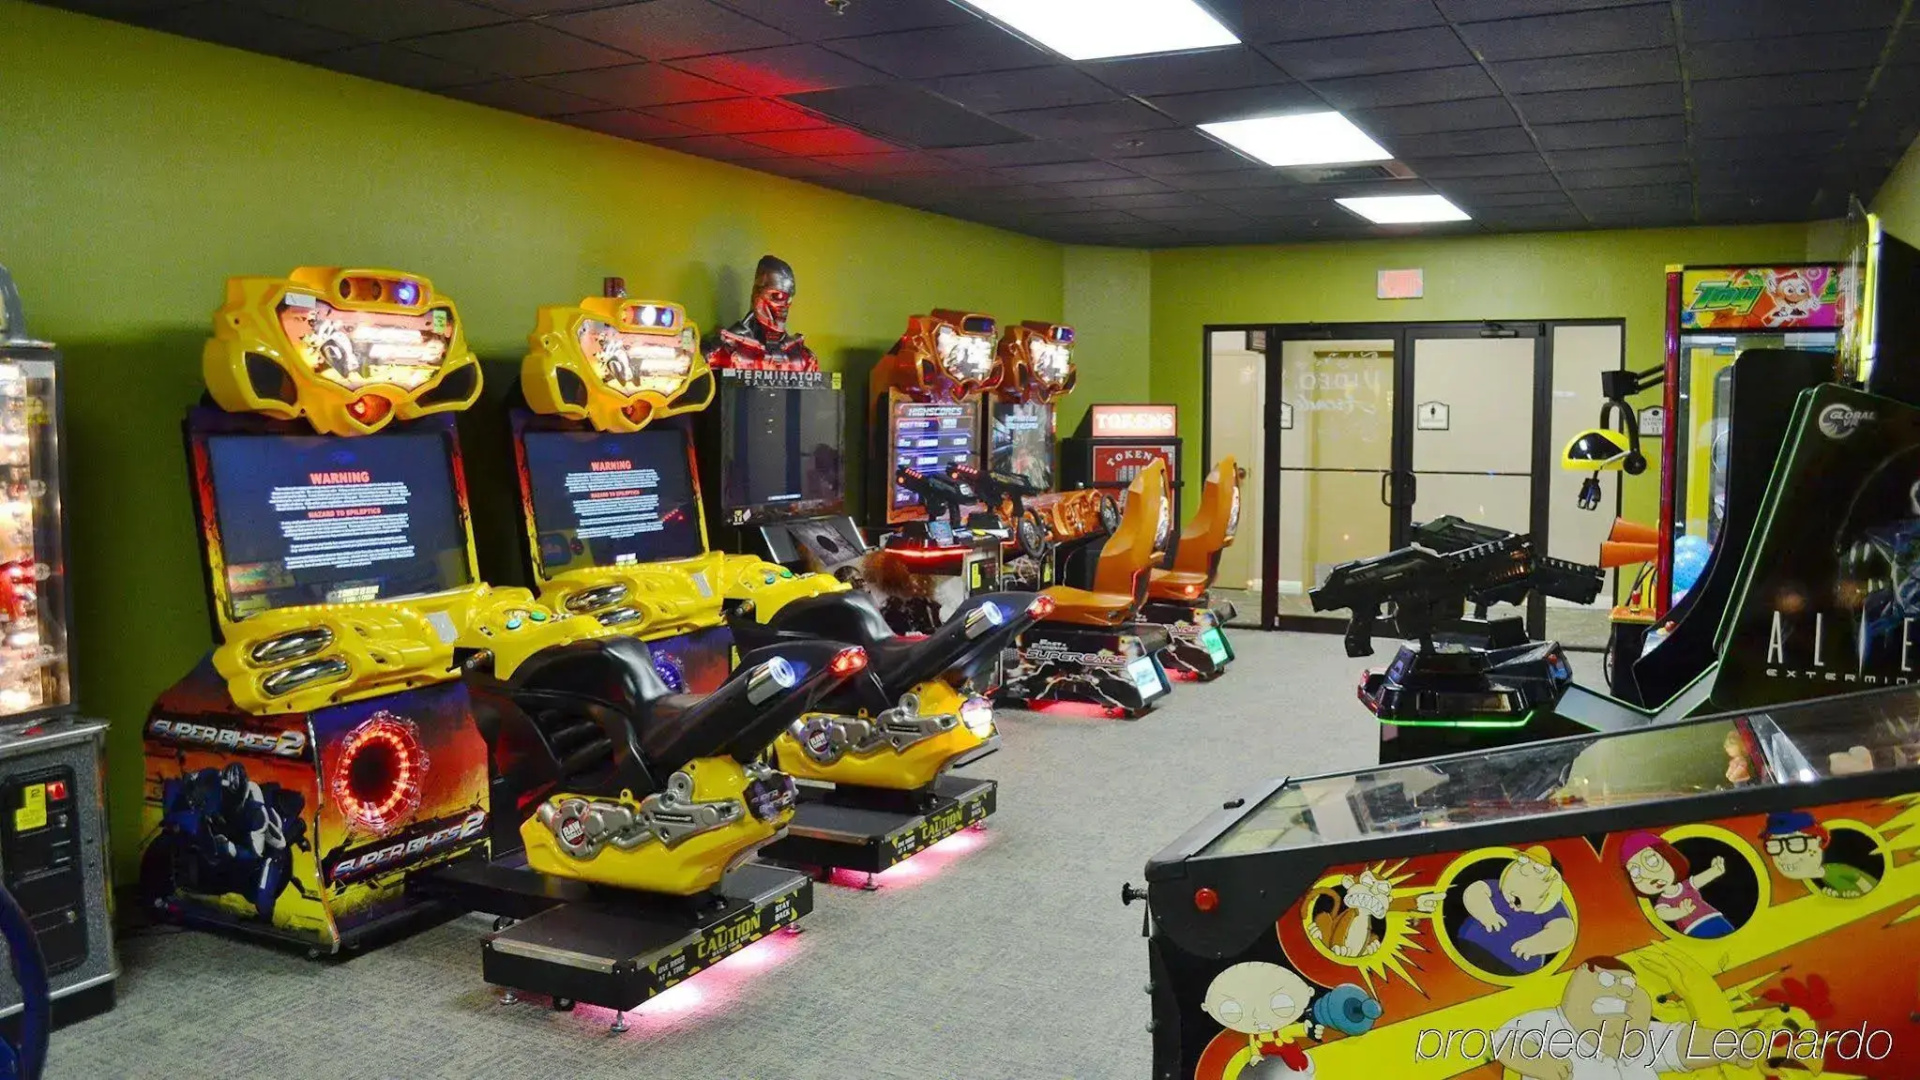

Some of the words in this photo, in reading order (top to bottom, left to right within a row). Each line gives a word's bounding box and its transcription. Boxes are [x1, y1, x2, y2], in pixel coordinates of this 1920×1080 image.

[1689, 280, 1767, 315] Toy
[736, 370, 823, 382] TERMINATOR
[1095, 412, 1173, 430] TOKENS
[1830, 411, 1875, 420] GLOBAL
[1843, 419, 1859, 428] VR
[590, 460, 632, 472] WARNING
[1106, 449, 1153, 467] TOKEN
[310, 471, 370, 485] WARNING
[308, 510, 335, 518] HAZARD
[335, 509, 346, 517] TO
[346, 507, 382, 516] EPILEPTICS
[1766, 668, 1920, 686] EXTERMIN
[274, 730, 306, 756] 2
[459, 810, 486, 839] 2
[562, 820, 581, 837] RAW
[921, 808, 964, 840] CAUTION
[774, 900, 790, 913] STAY
[774, 908, 791, 922] BACK
[697, 912, 762, 959] CAUTION
